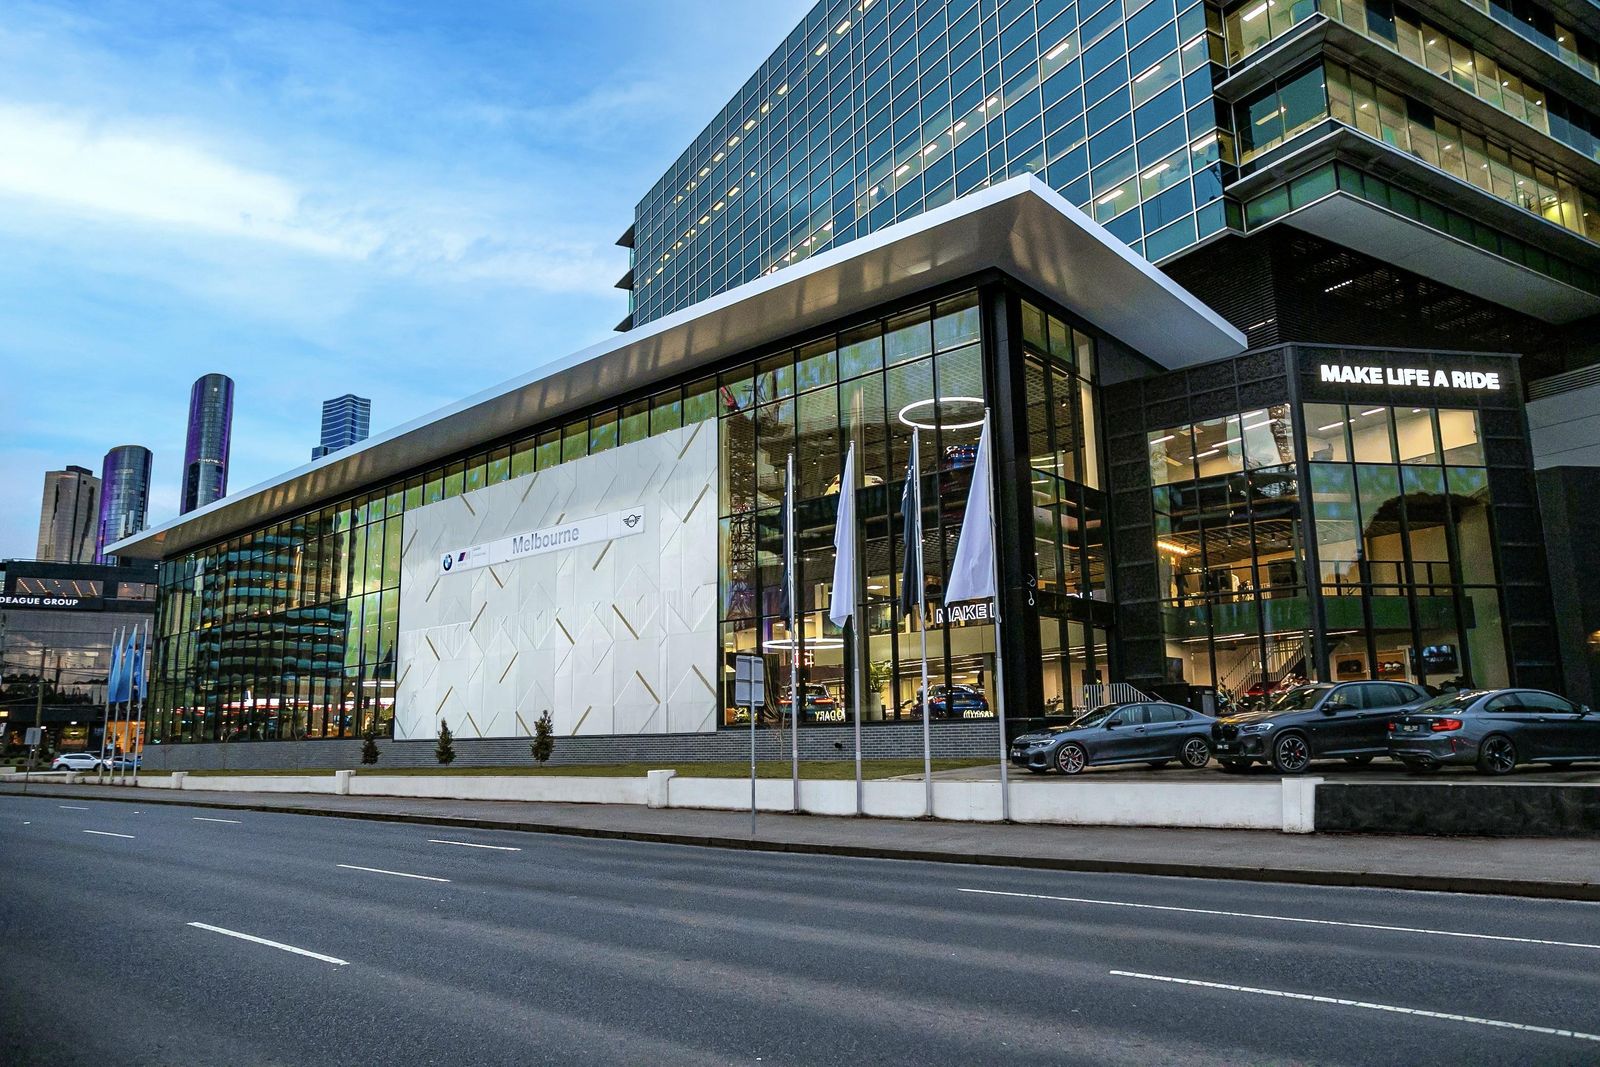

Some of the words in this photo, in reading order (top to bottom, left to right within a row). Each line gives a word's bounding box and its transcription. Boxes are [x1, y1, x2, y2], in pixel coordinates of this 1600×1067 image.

[1320, 364, 1383, 384] MAKE
[1386, 367, 1430, 387] LIFE
[1433, 370, 1449, 388] A
[1451, 371, 1500, 390] RIDE
[512, 527, 579, 554] Melbourne
[0, 596, 40, 605] DEAGUE
[43, 598, 79, 606] GROUP
[936, 603, 987, 624] MAKE
